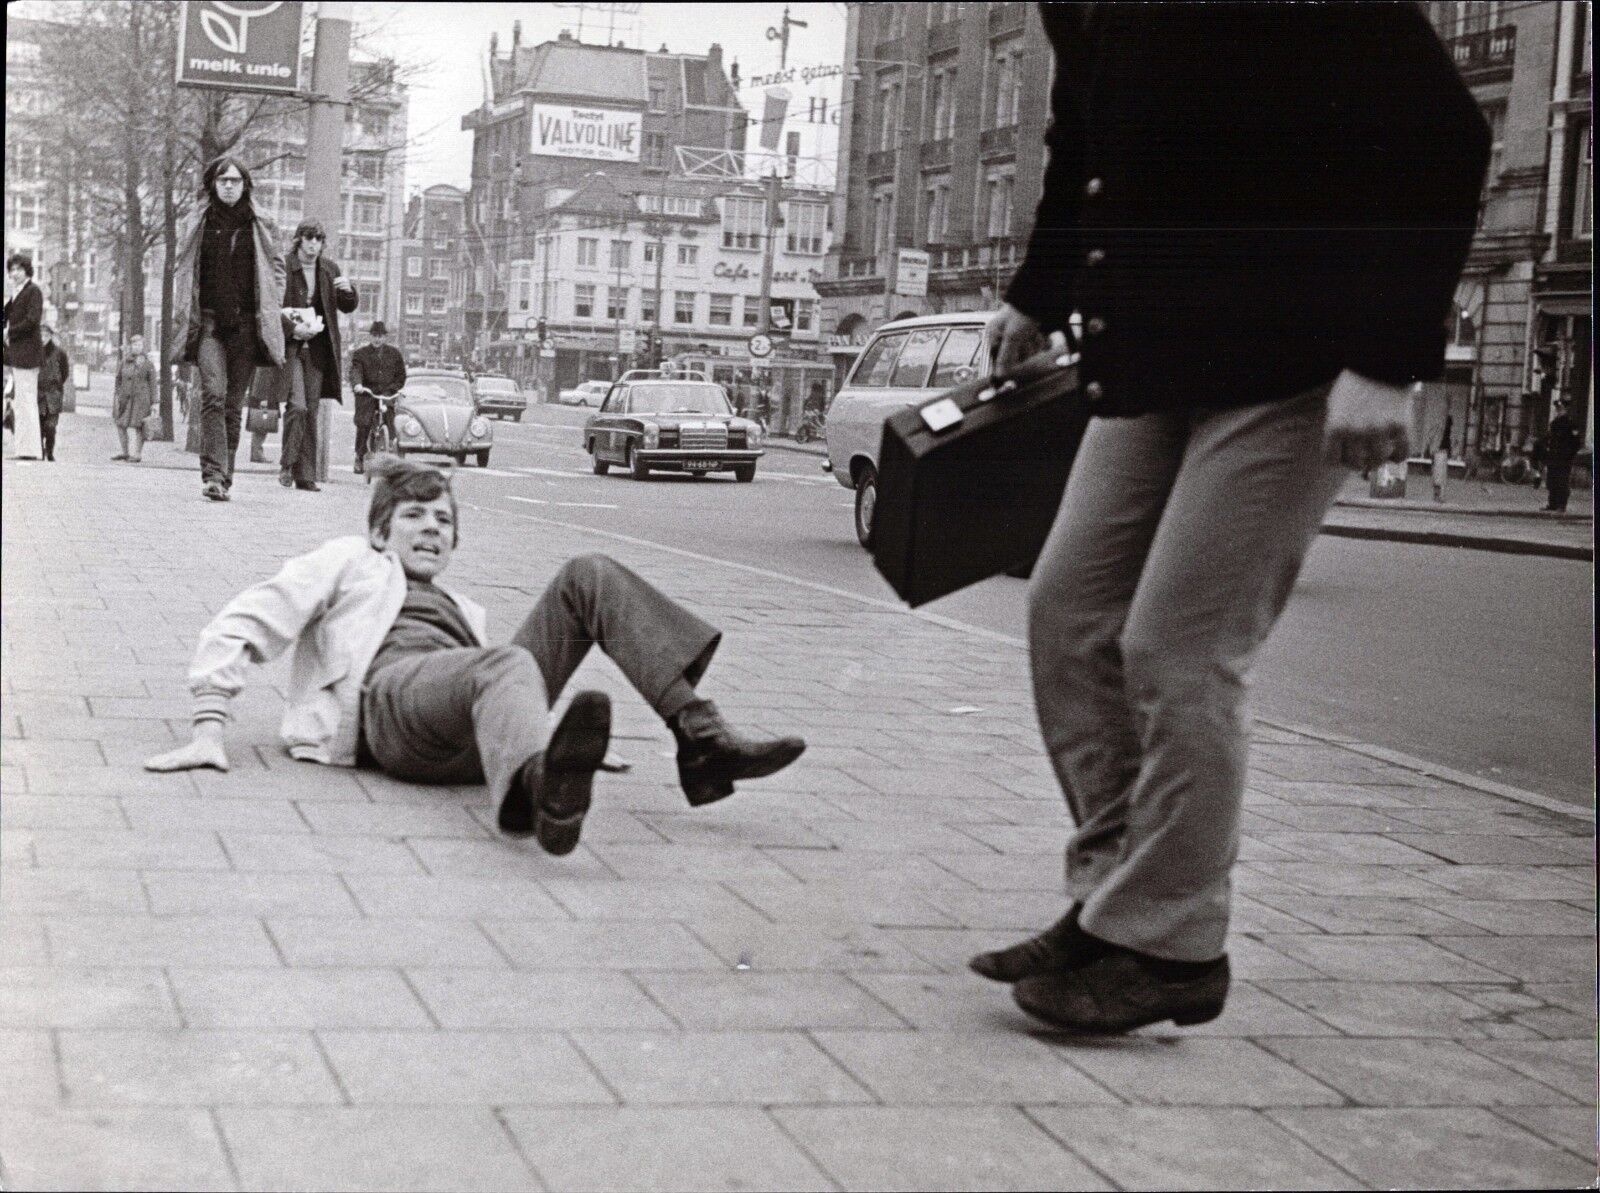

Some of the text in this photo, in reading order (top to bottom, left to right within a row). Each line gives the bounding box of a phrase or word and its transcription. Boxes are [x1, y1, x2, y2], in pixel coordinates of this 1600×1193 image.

[190, 58, 292, 78] melk unie
[539, 112, 636, 154] VALVOLINE
